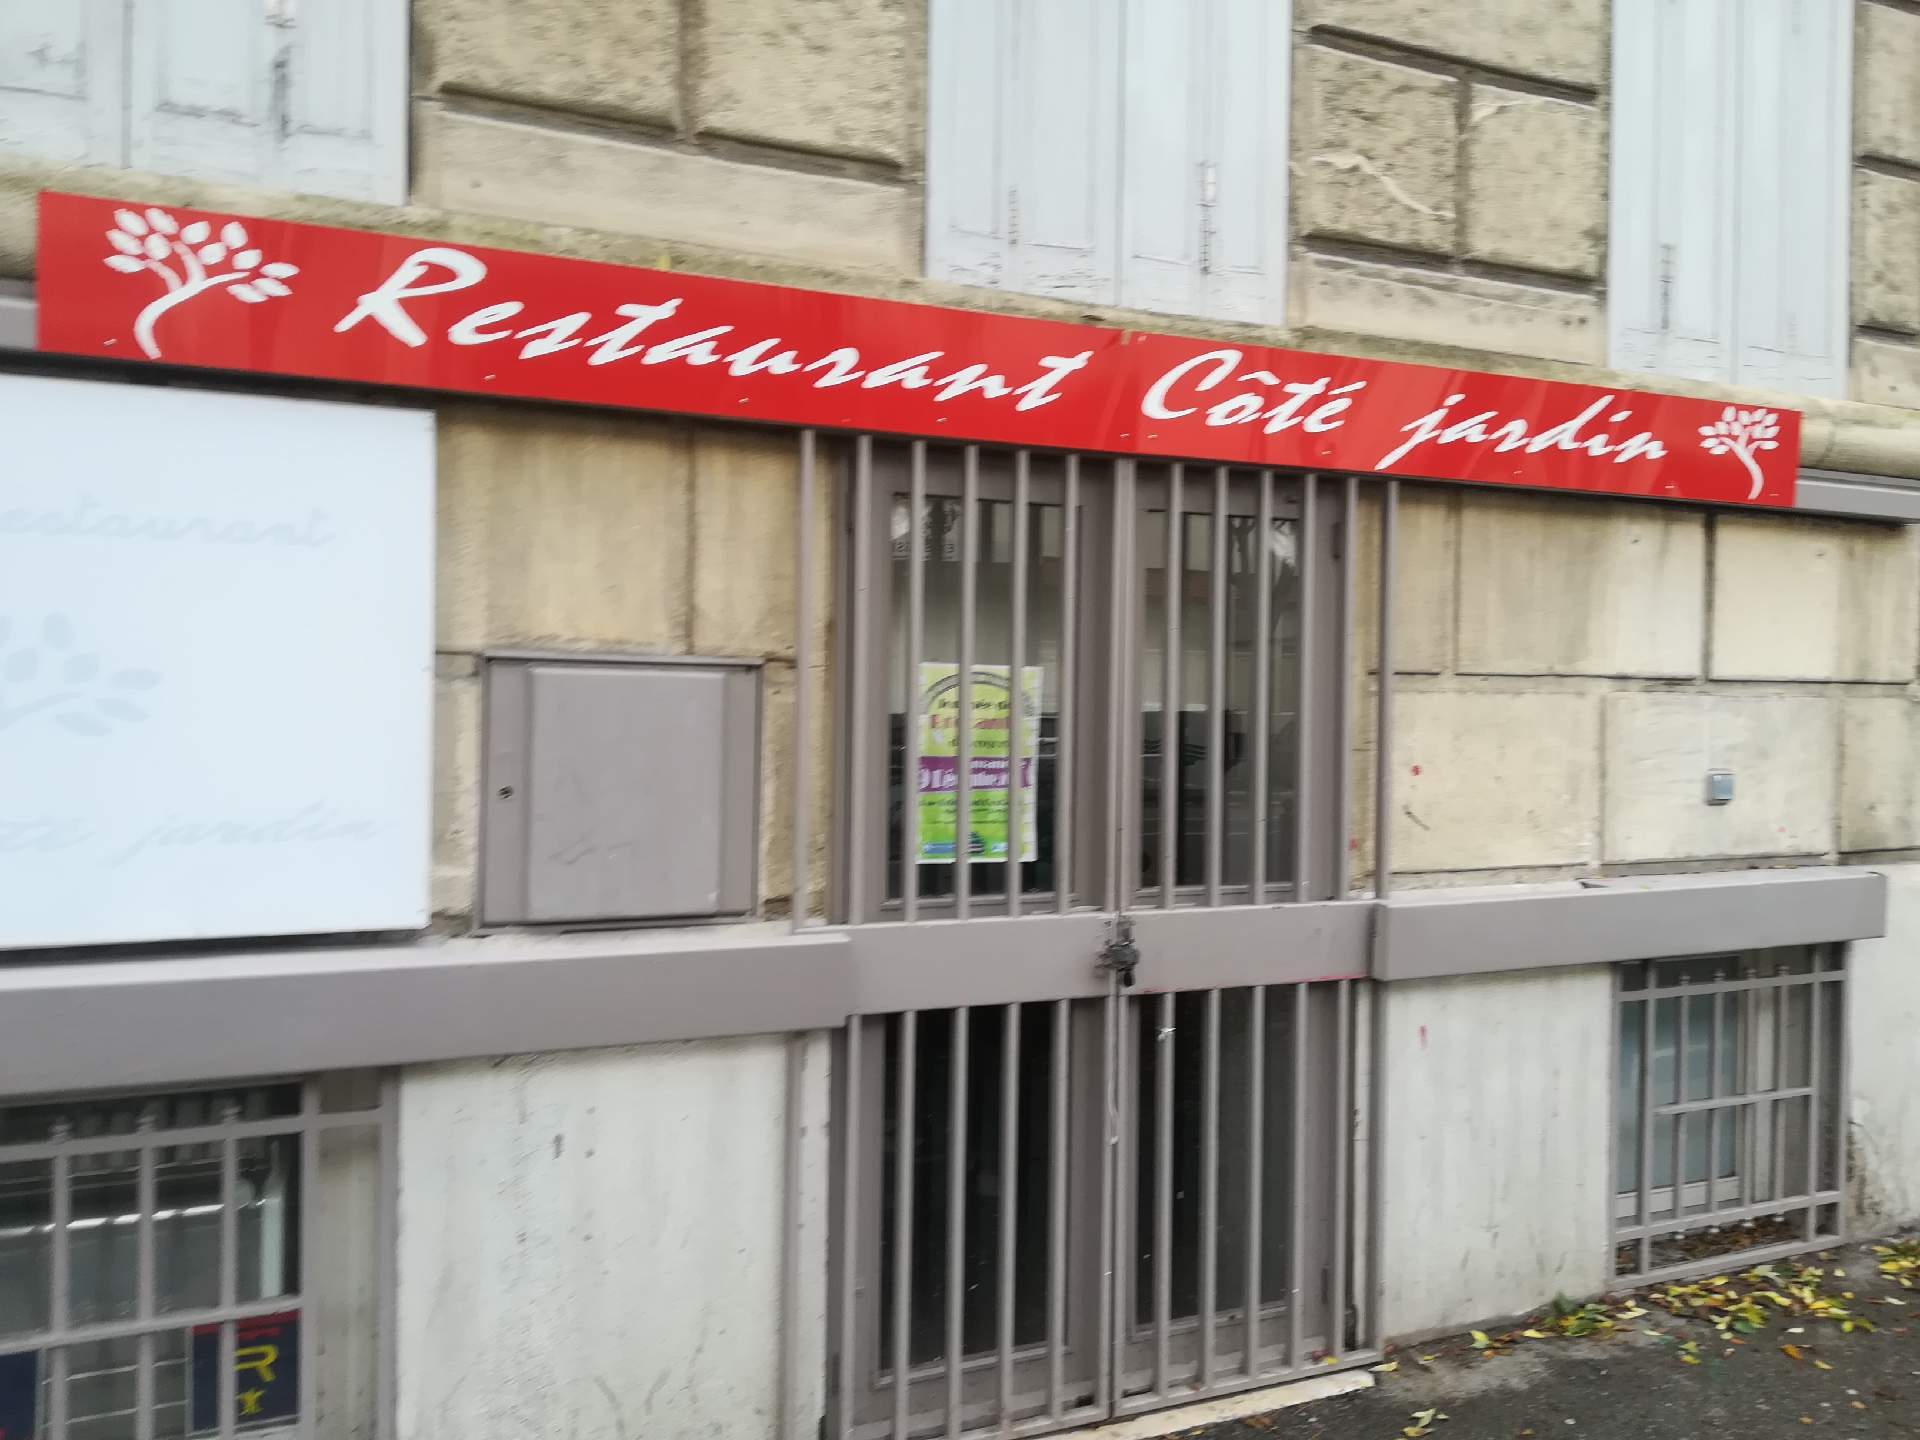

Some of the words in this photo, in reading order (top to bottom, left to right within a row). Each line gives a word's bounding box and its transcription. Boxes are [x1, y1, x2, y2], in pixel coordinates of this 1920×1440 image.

[334, 246, 1094, 413] Restaurant
[1140, 348, 1368, 435] Côté
[1374, 393, 1669, 471] jardin
